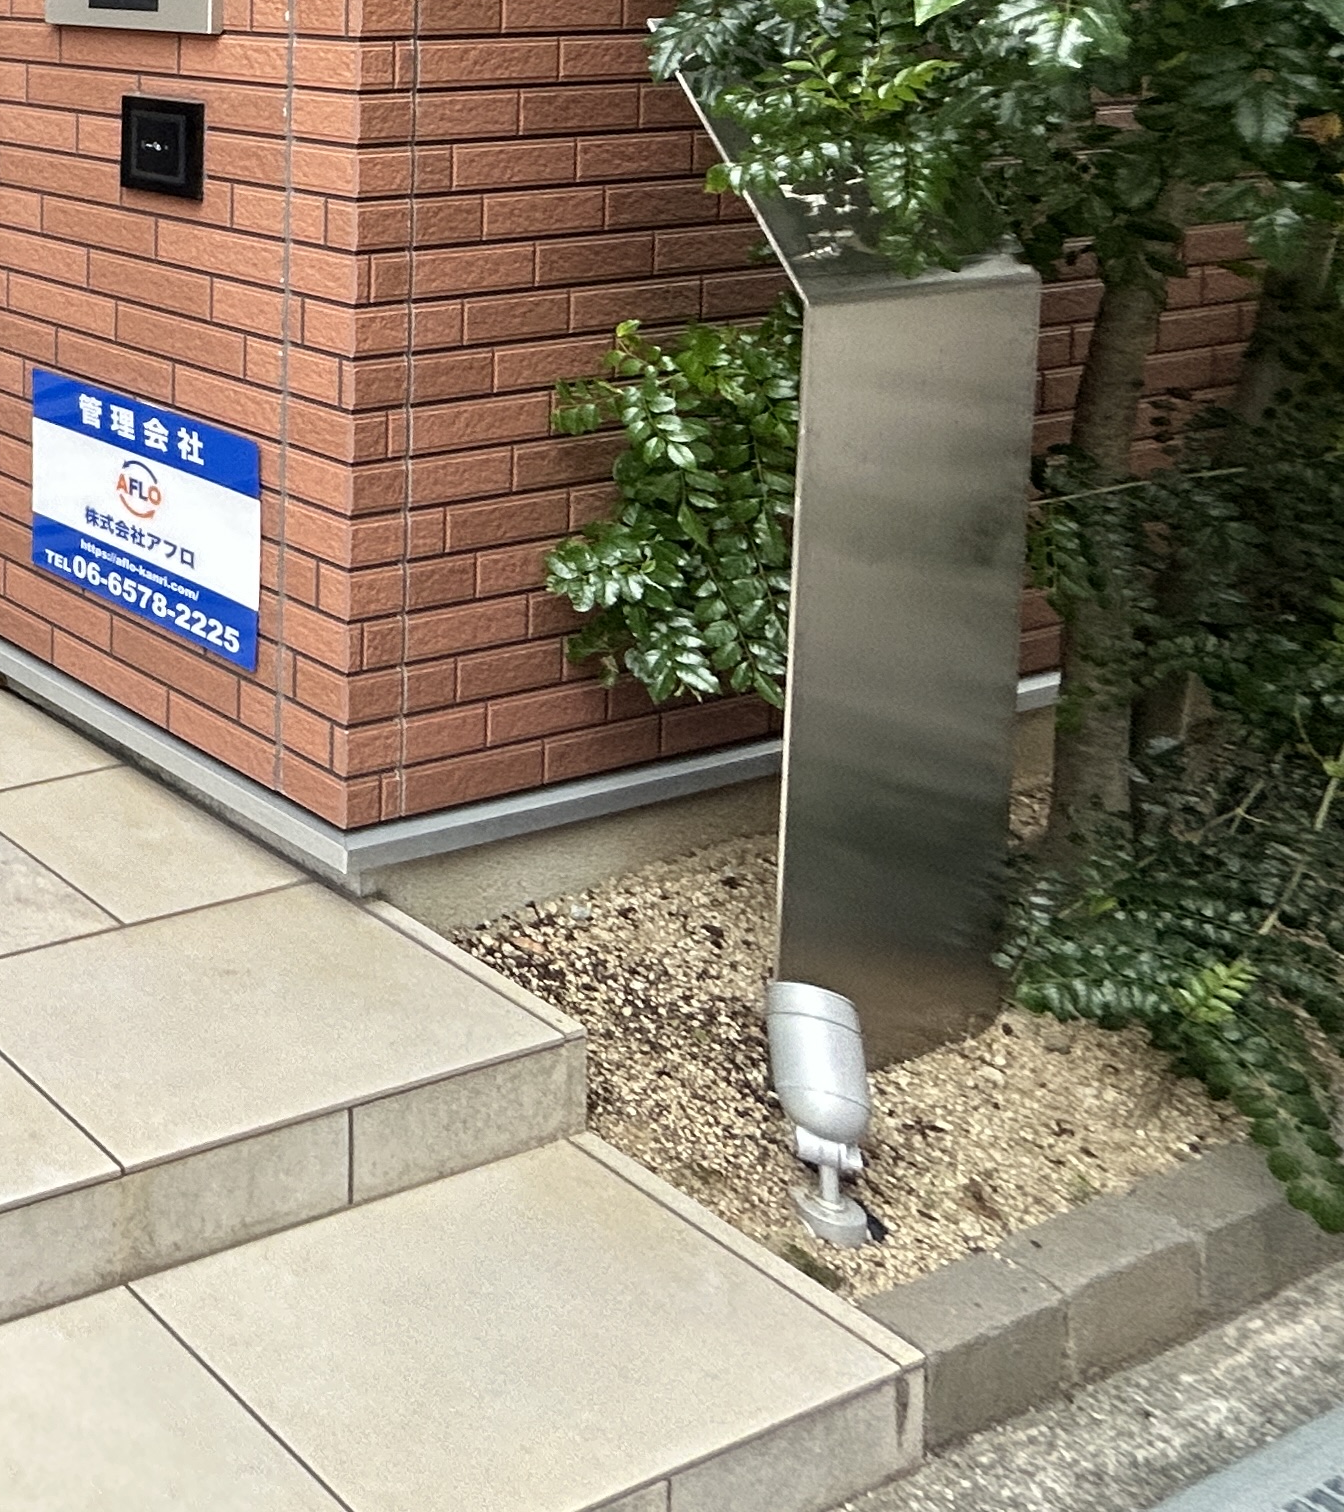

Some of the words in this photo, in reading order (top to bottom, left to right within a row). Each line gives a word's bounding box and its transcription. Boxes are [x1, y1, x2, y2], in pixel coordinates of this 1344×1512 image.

[78, 393, 205, 466] 管理会社
[116, 473, 162, 506] AFLO
[85, 505, 196, 569] 株式会社アフロ
[80, 538, 200, 601] https://aflo-kanri.com/
[72, 555, 241, 653] 06-6578-2225
